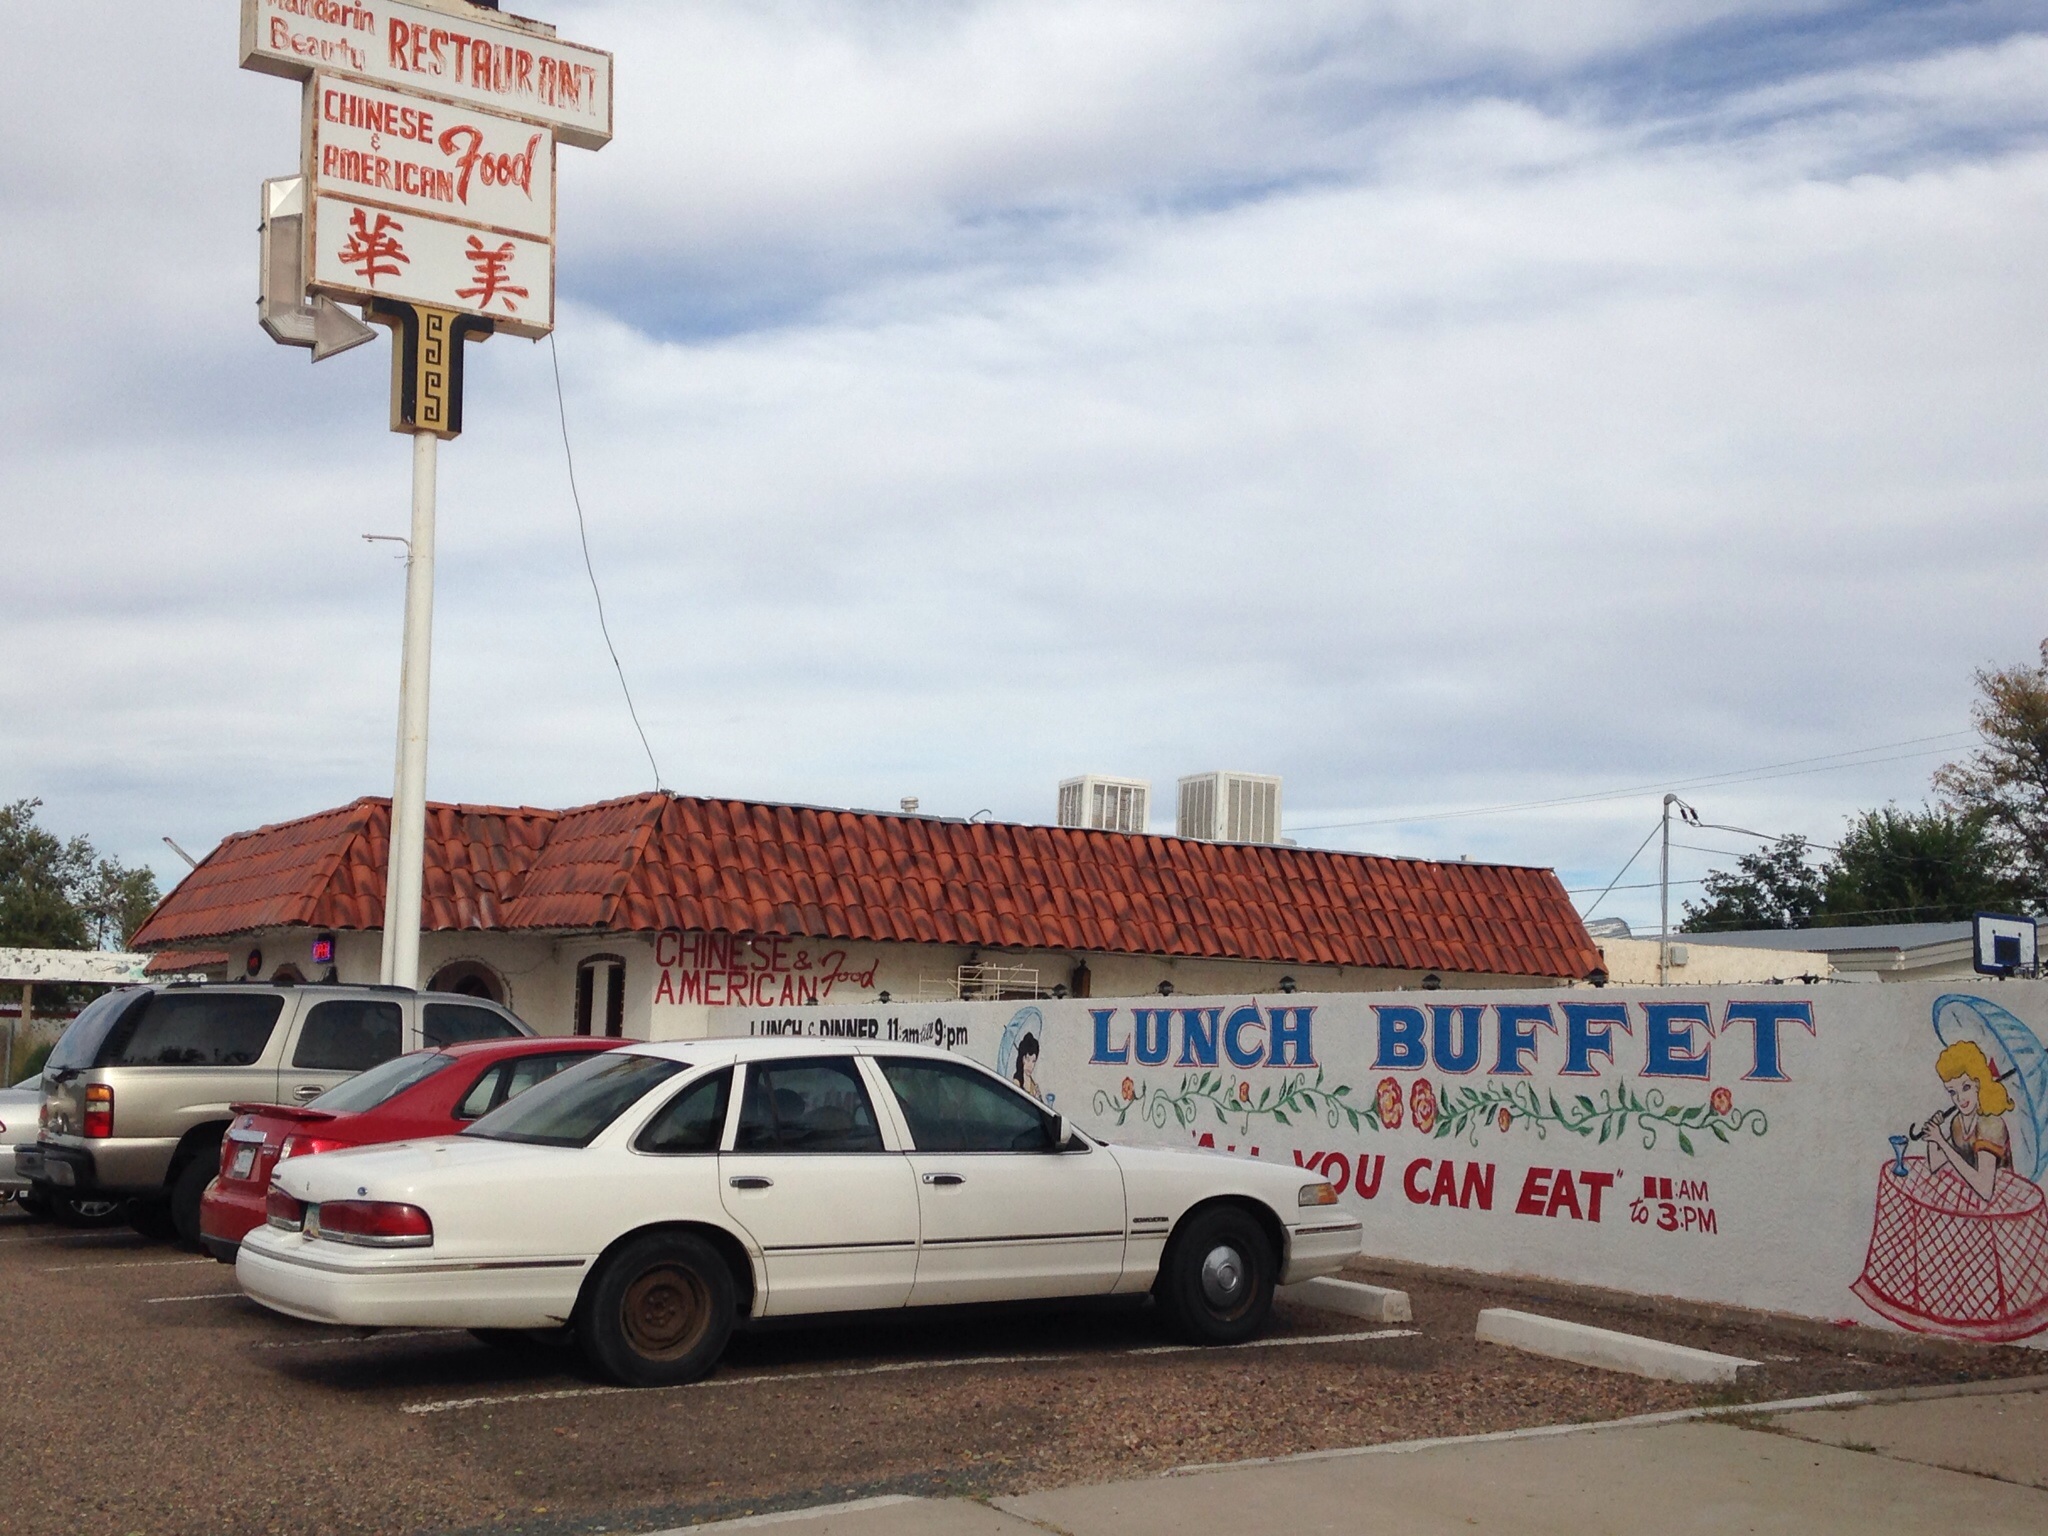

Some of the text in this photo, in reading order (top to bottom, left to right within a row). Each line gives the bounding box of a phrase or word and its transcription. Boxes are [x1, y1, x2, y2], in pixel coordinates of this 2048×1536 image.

[264, 0, 375, 35] andarin
[270, 16, 366, 71] Beauty
[388, 17, 598, 116] RESTAURANT
[324, 89, 434, 144] CHINESE
[322, 144, 454, 203] AMERICAN
[438, 124, 543, 206] Food
[655, 932, 813, 972] CHINESE &
[820, 950, 880, 998] Food
[654, 969, 818, 1007] AMERICAN
[1088, 997, 1816, 1083] LUNCH BUFFET
[1403, 1157, 1496, 1210] CAN
[1629, 1196, 1718, 1235] to 3:PM
